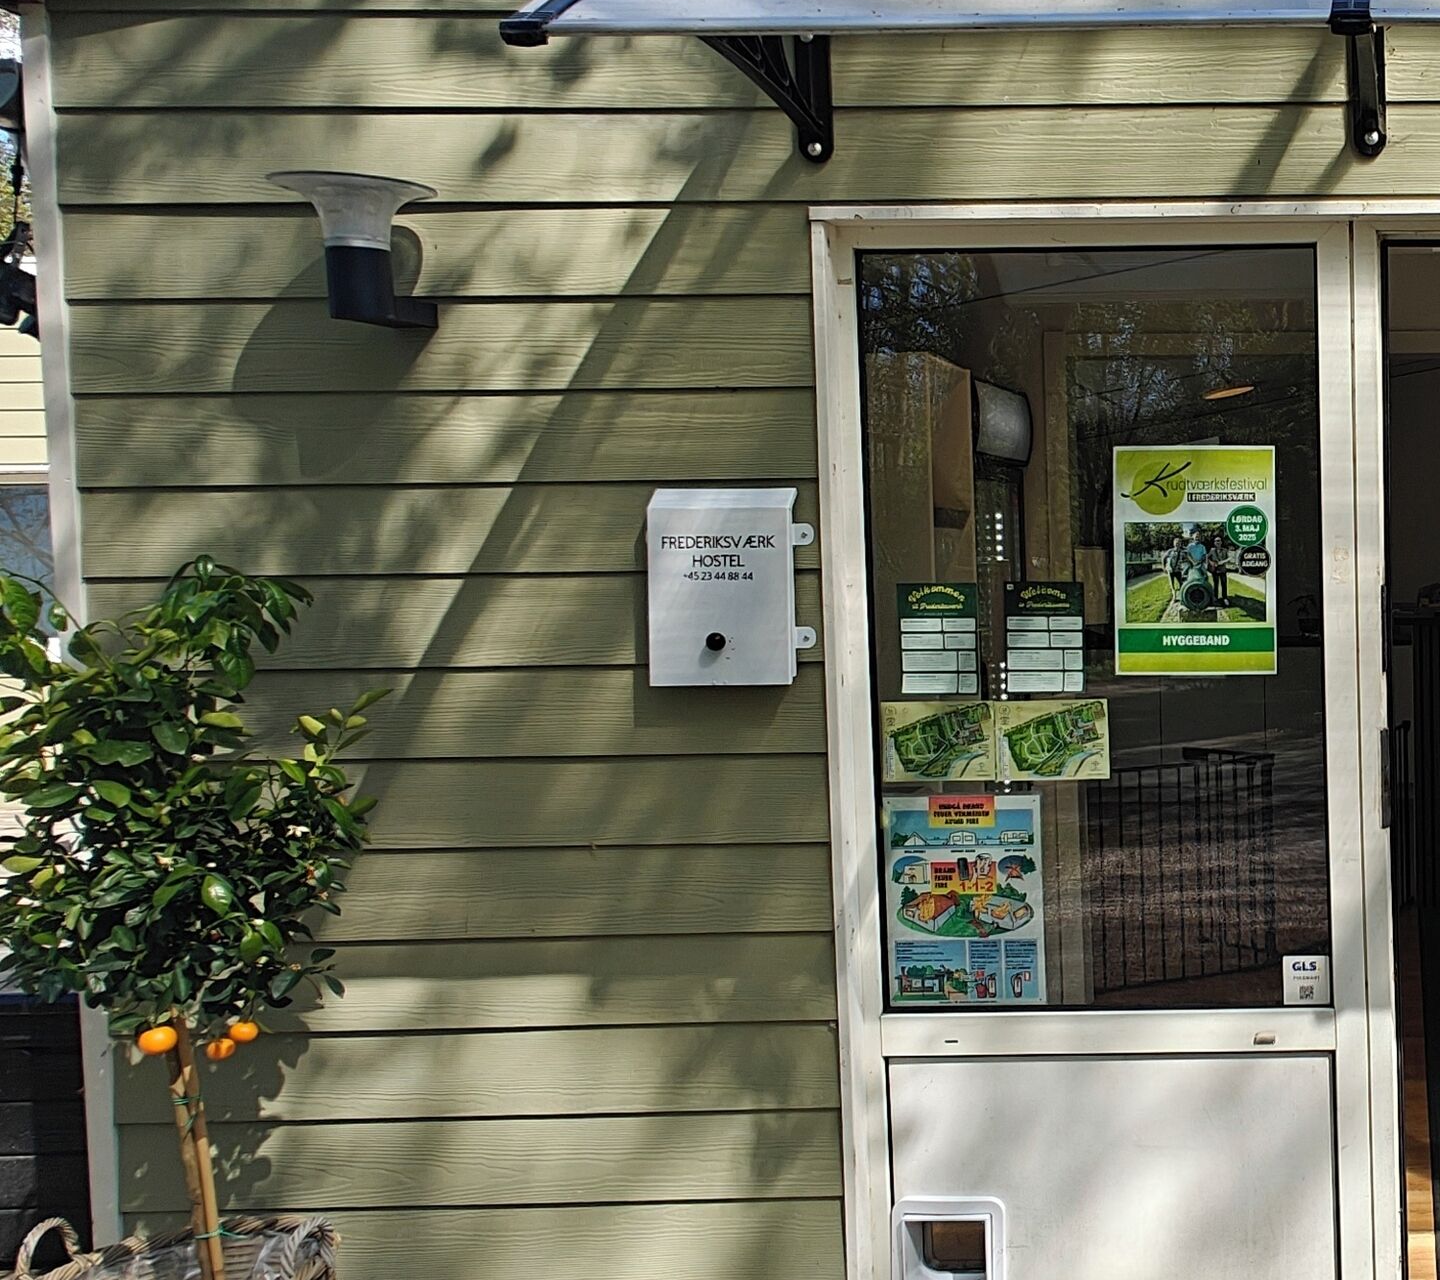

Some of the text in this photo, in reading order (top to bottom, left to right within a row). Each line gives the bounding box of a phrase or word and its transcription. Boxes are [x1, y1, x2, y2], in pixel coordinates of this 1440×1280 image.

[1121, 462, 1267, 498] Krudtværksfestival
[1231, 515, 1263, 524] LØRDAG
[660, 535, 776, 550] FREDERIKSVÆRK
[692, 555, 745, 568] HOSTEL
[1243, 552, 1266, 560] GRATIS
[701, 571, 712, 581] 23
[714, 572, 726, 581] 44
[727, 571, 740, 581] 88
[741, 572, 753, 581] 44
[1162, 634, 1231, 647] HYGGEBAND
[959, 880, 994, 893] 1-1-2
